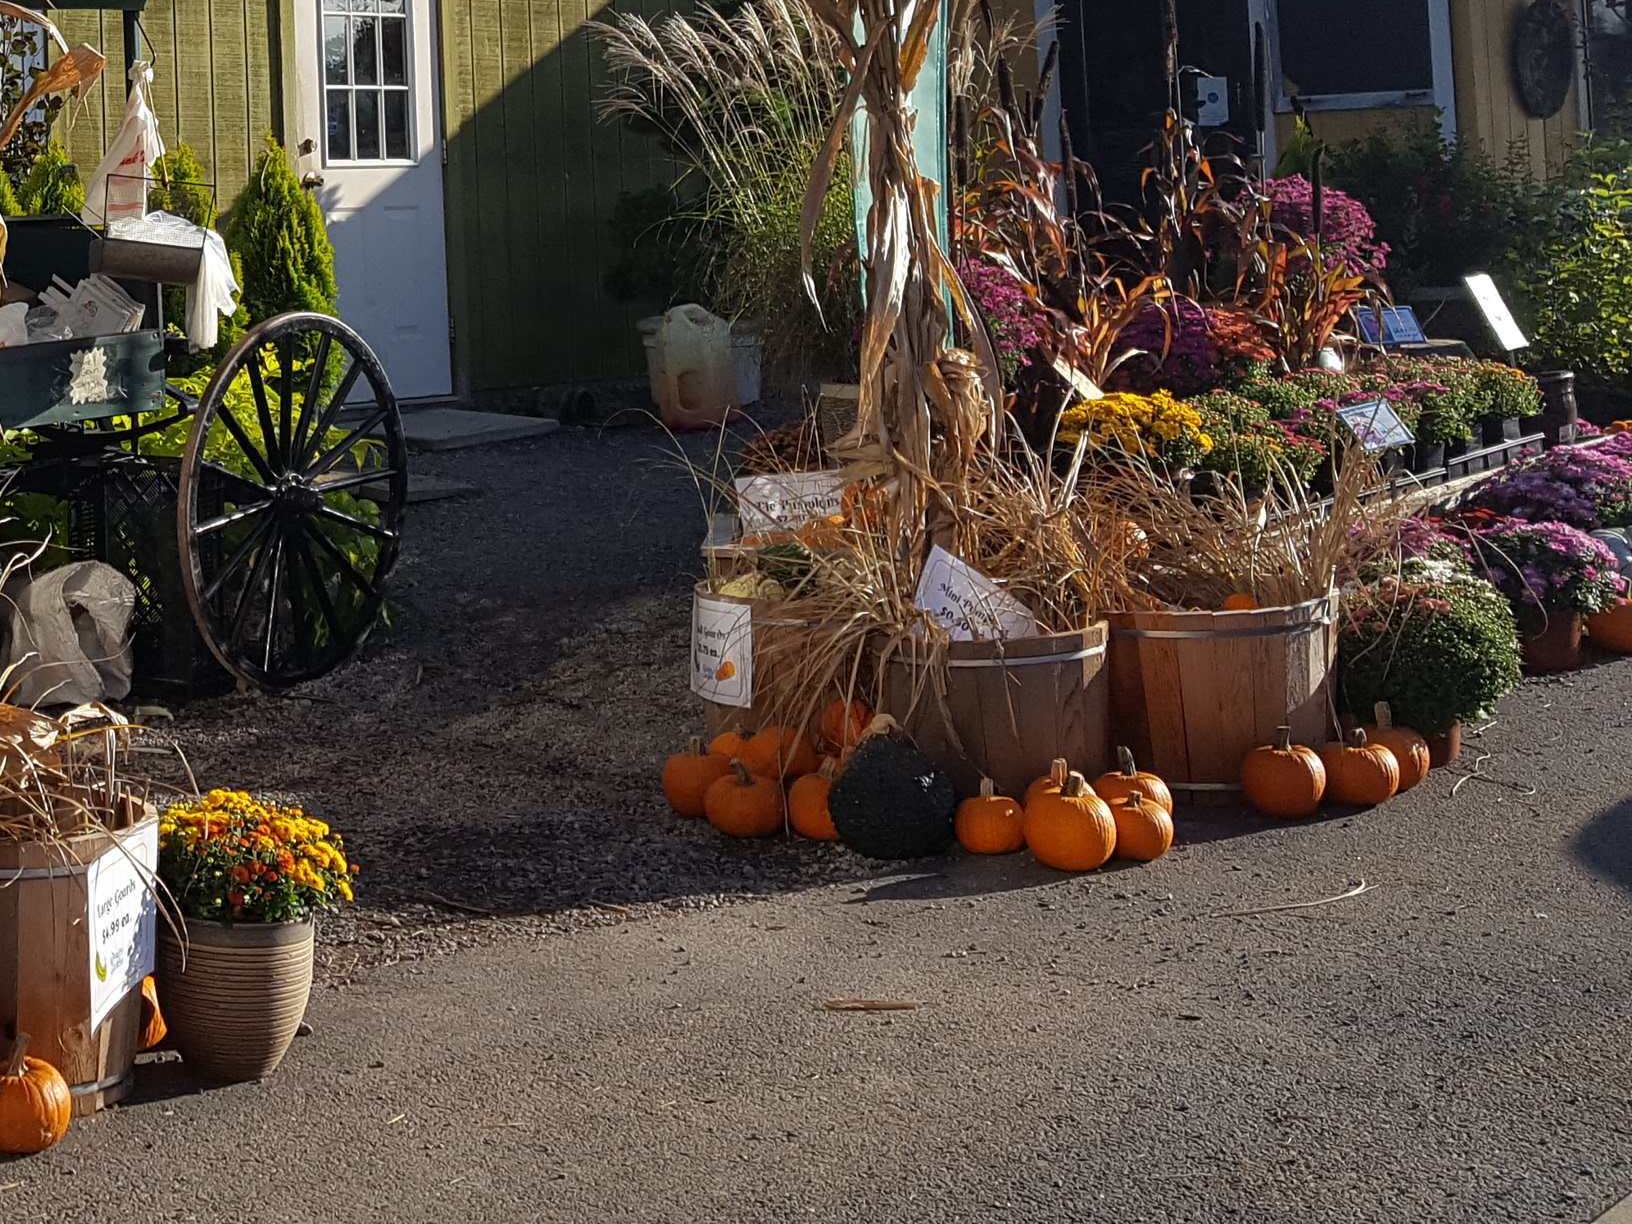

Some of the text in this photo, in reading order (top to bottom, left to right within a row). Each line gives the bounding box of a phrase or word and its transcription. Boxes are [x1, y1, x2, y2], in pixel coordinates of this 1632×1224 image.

[937, 582, 961, 605] Mini
[96, 878, 137, 919] Large Gourds
